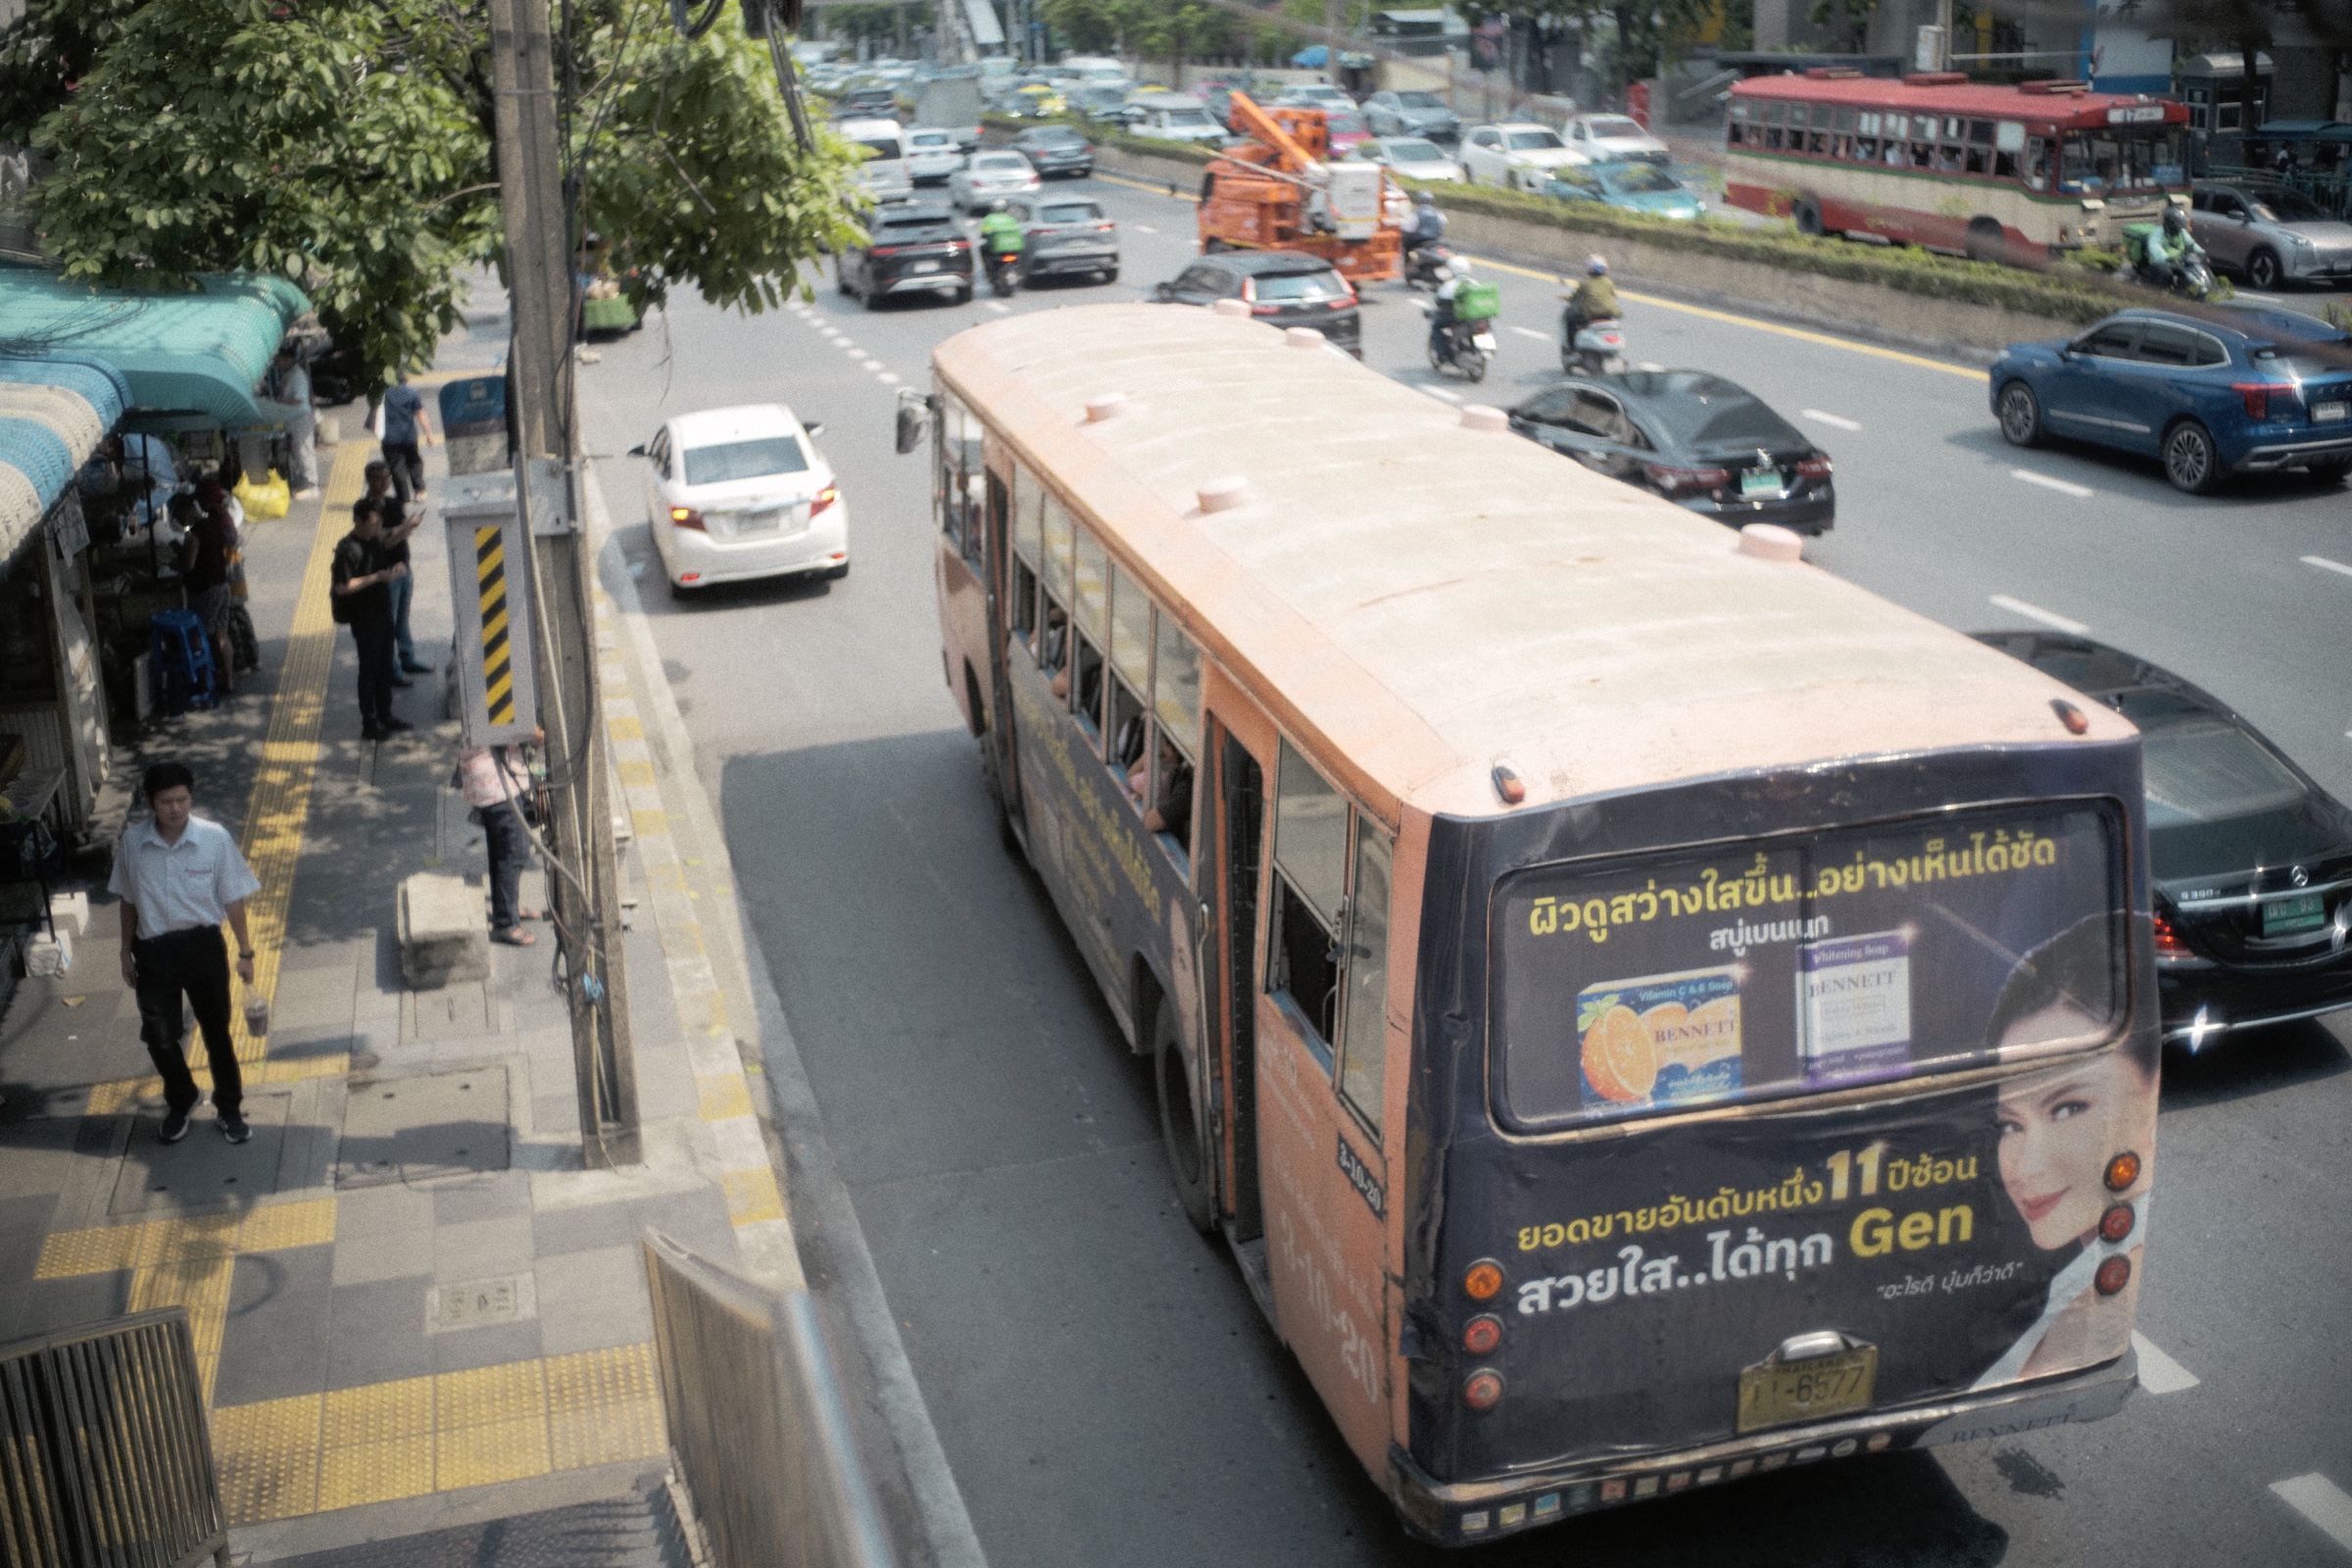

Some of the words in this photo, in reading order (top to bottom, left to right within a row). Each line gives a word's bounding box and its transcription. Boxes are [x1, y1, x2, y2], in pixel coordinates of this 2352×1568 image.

[1640, 988, 1677, 1001] Vitamin
[1810, 971, 1894, 998] BENNETT
[1655, 1019, 1735, 1043] BENNETT
[1519, 1166, 1824, 1251] ยอดขายอันดับหนึ่ง
[1827, 1142, 1883, 1200] 11
[1887, 1152, 1978, 1193] ปีซ้อน
[1518, 1226, 1834, 1315] สวยใส..ได้ทุก
[1850, 1204, 1974, 1258] Gen
